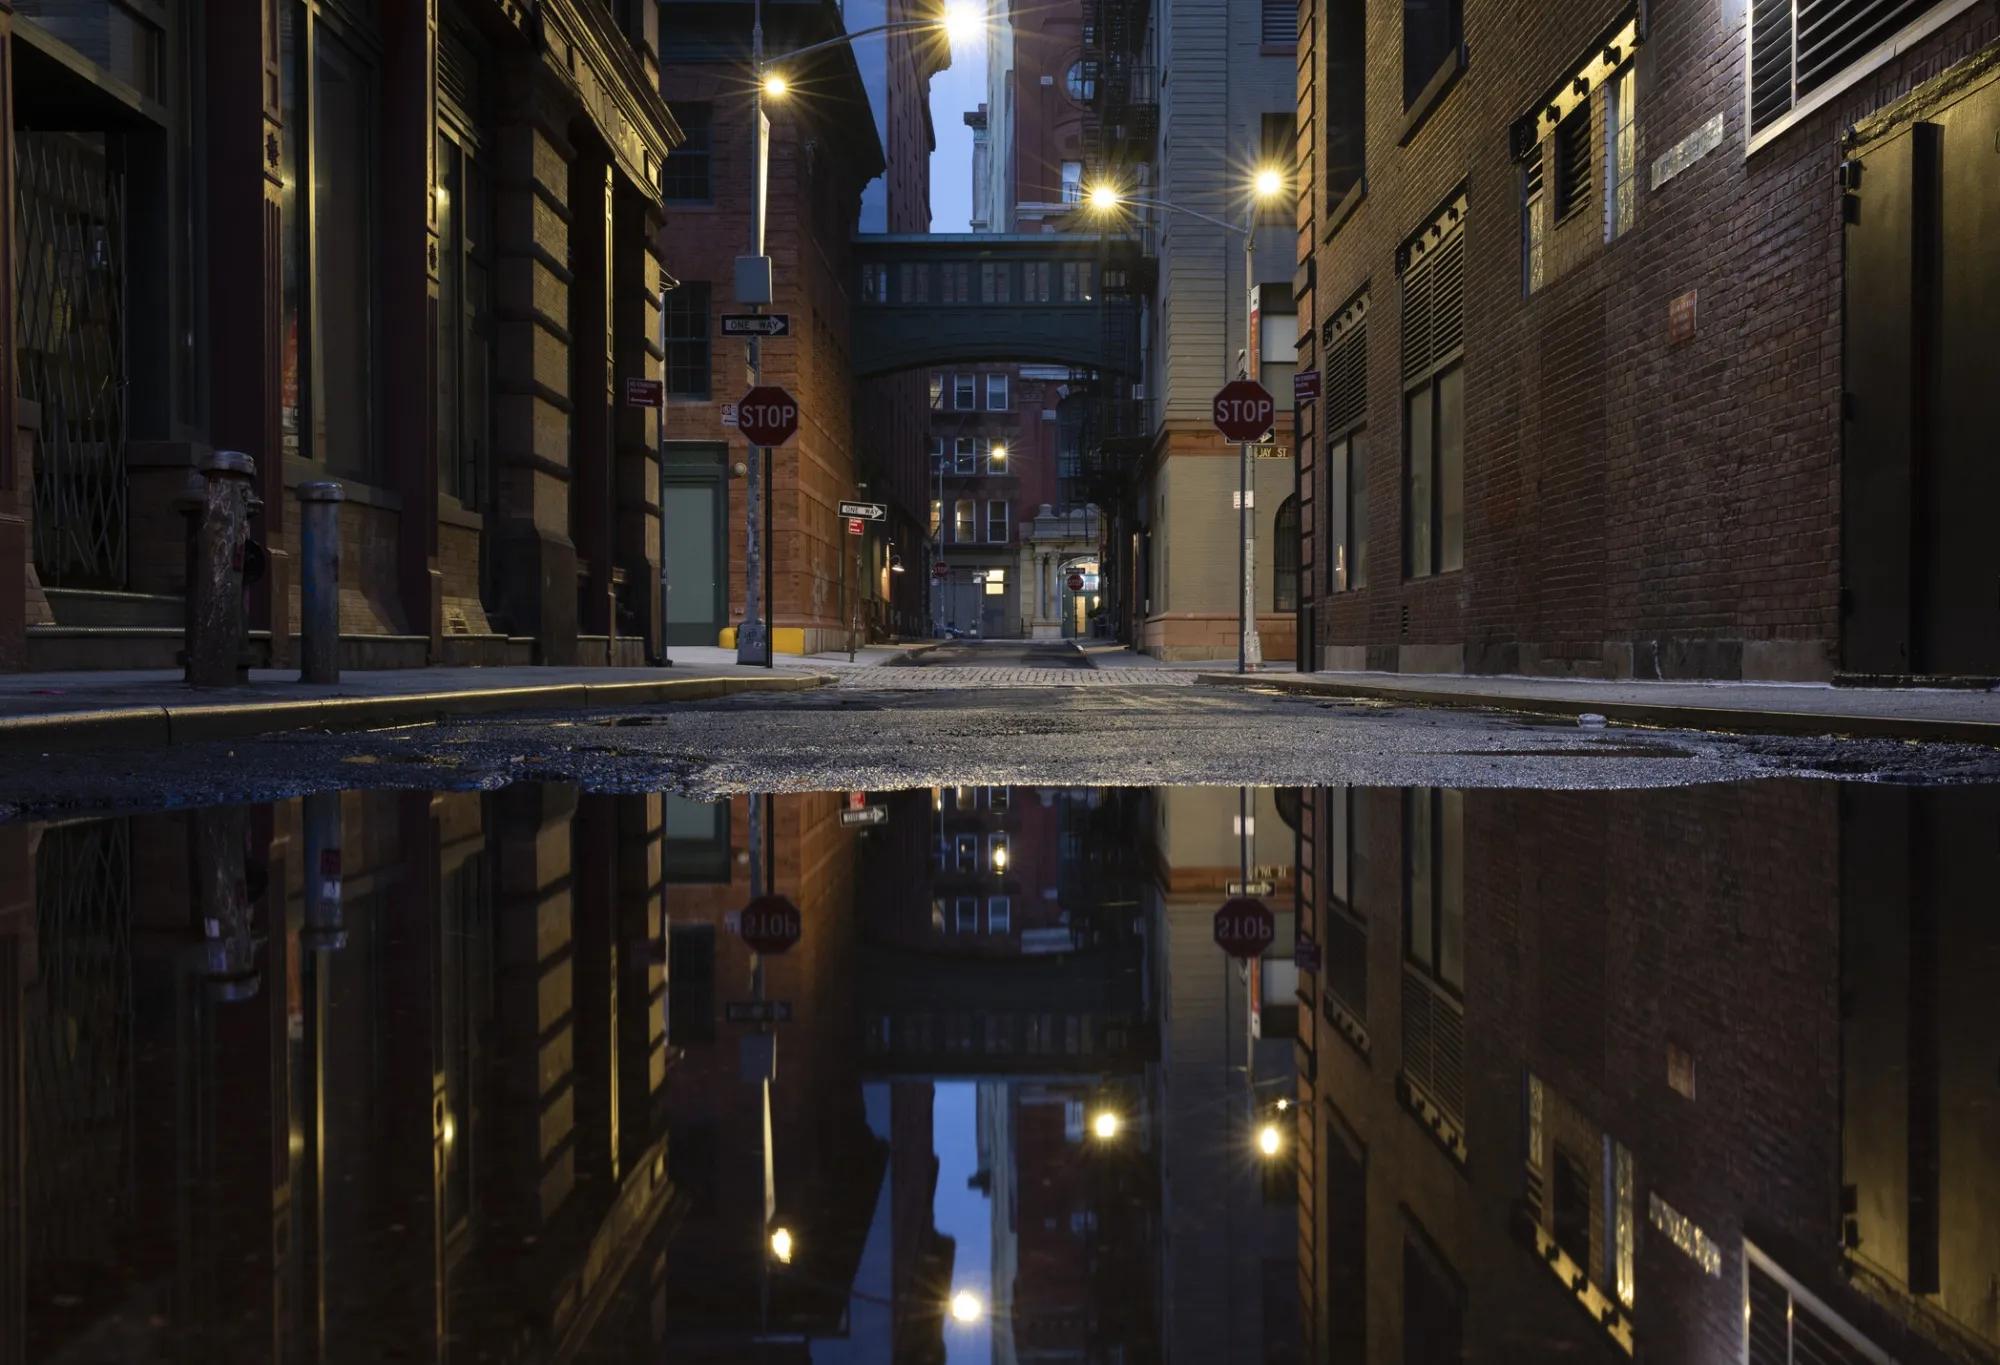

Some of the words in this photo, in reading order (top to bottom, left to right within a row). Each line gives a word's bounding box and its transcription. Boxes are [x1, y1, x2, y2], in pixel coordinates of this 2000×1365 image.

[730, 320, 750, 330] ONE
[758, 320, 779, 330] WAY
[742, 405, 795, 428] STOP
[1216, 400, 1271, 423] STOP
[1258, 448, 1272, 457] JAY
[1277, 448, 1287, 457] ST
[845, 506, 859, 514] ONE
[864, 508, 879, 516] WAY
[934, 566, 948, 574] STOP
